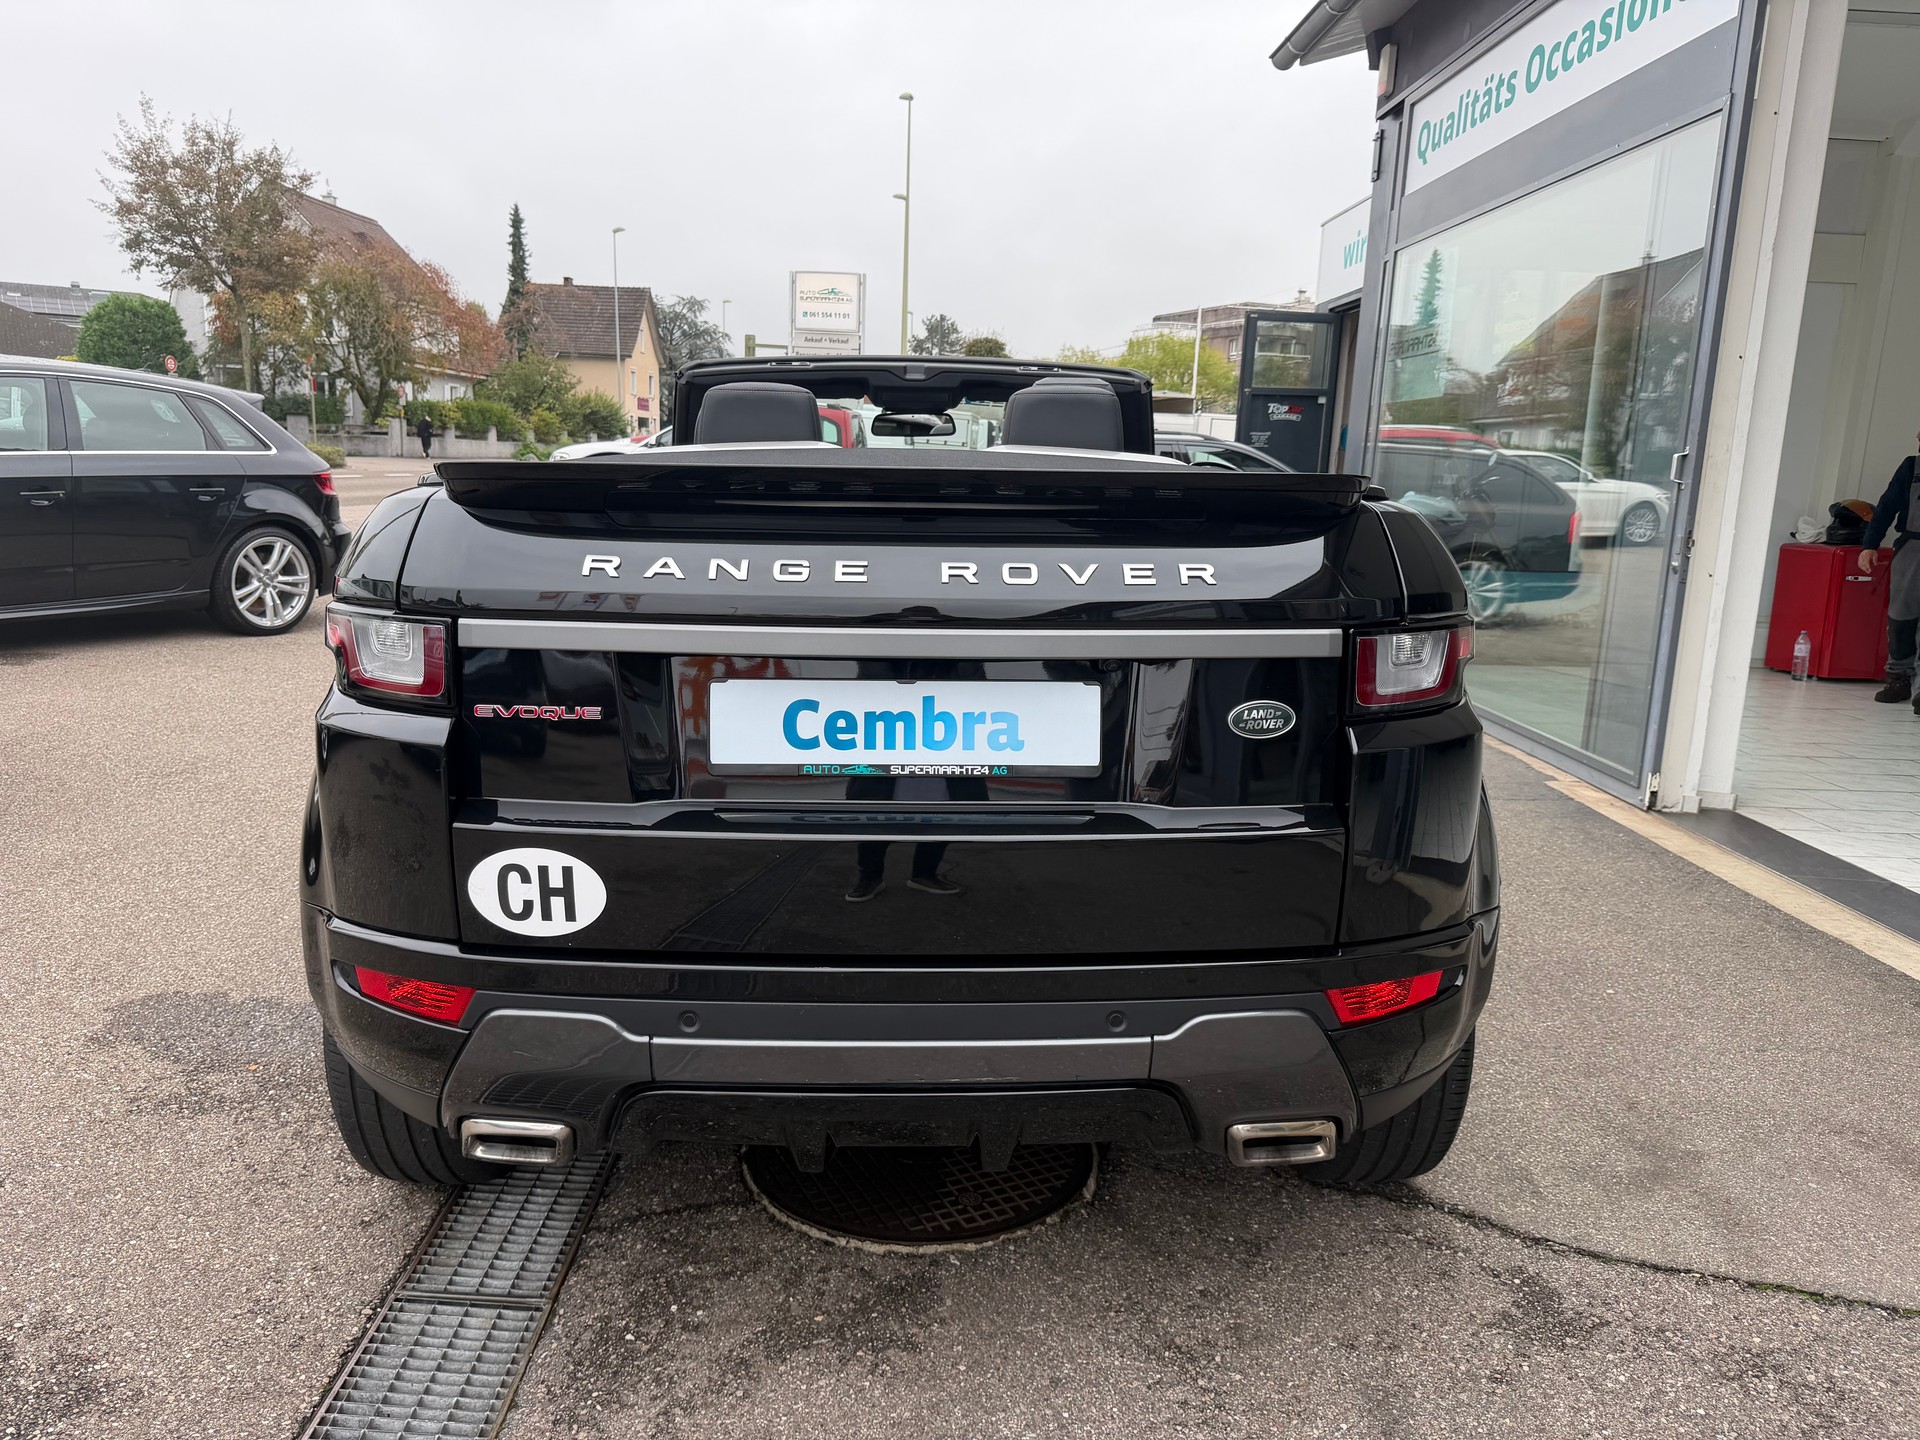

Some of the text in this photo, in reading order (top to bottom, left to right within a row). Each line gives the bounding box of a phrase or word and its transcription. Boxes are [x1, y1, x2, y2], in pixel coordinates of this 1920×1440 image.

[1417, 0, 1688, 165] Qualitäts Occasio
[821, 311, 833, 319] 554
[581, 554, 1218, 586] RANGE ROVER
[473, 704, 602, 721] EVOQUE
[1243, 709, 1275, 720] LAND
[782, 695, 1026, 752] Cembra
[1246, 719, 1285, 730] ROVER
[803, 765, 1008, 775] AUTO SUPERMARKT24 AG
[496, 862, 577, 923] CH
